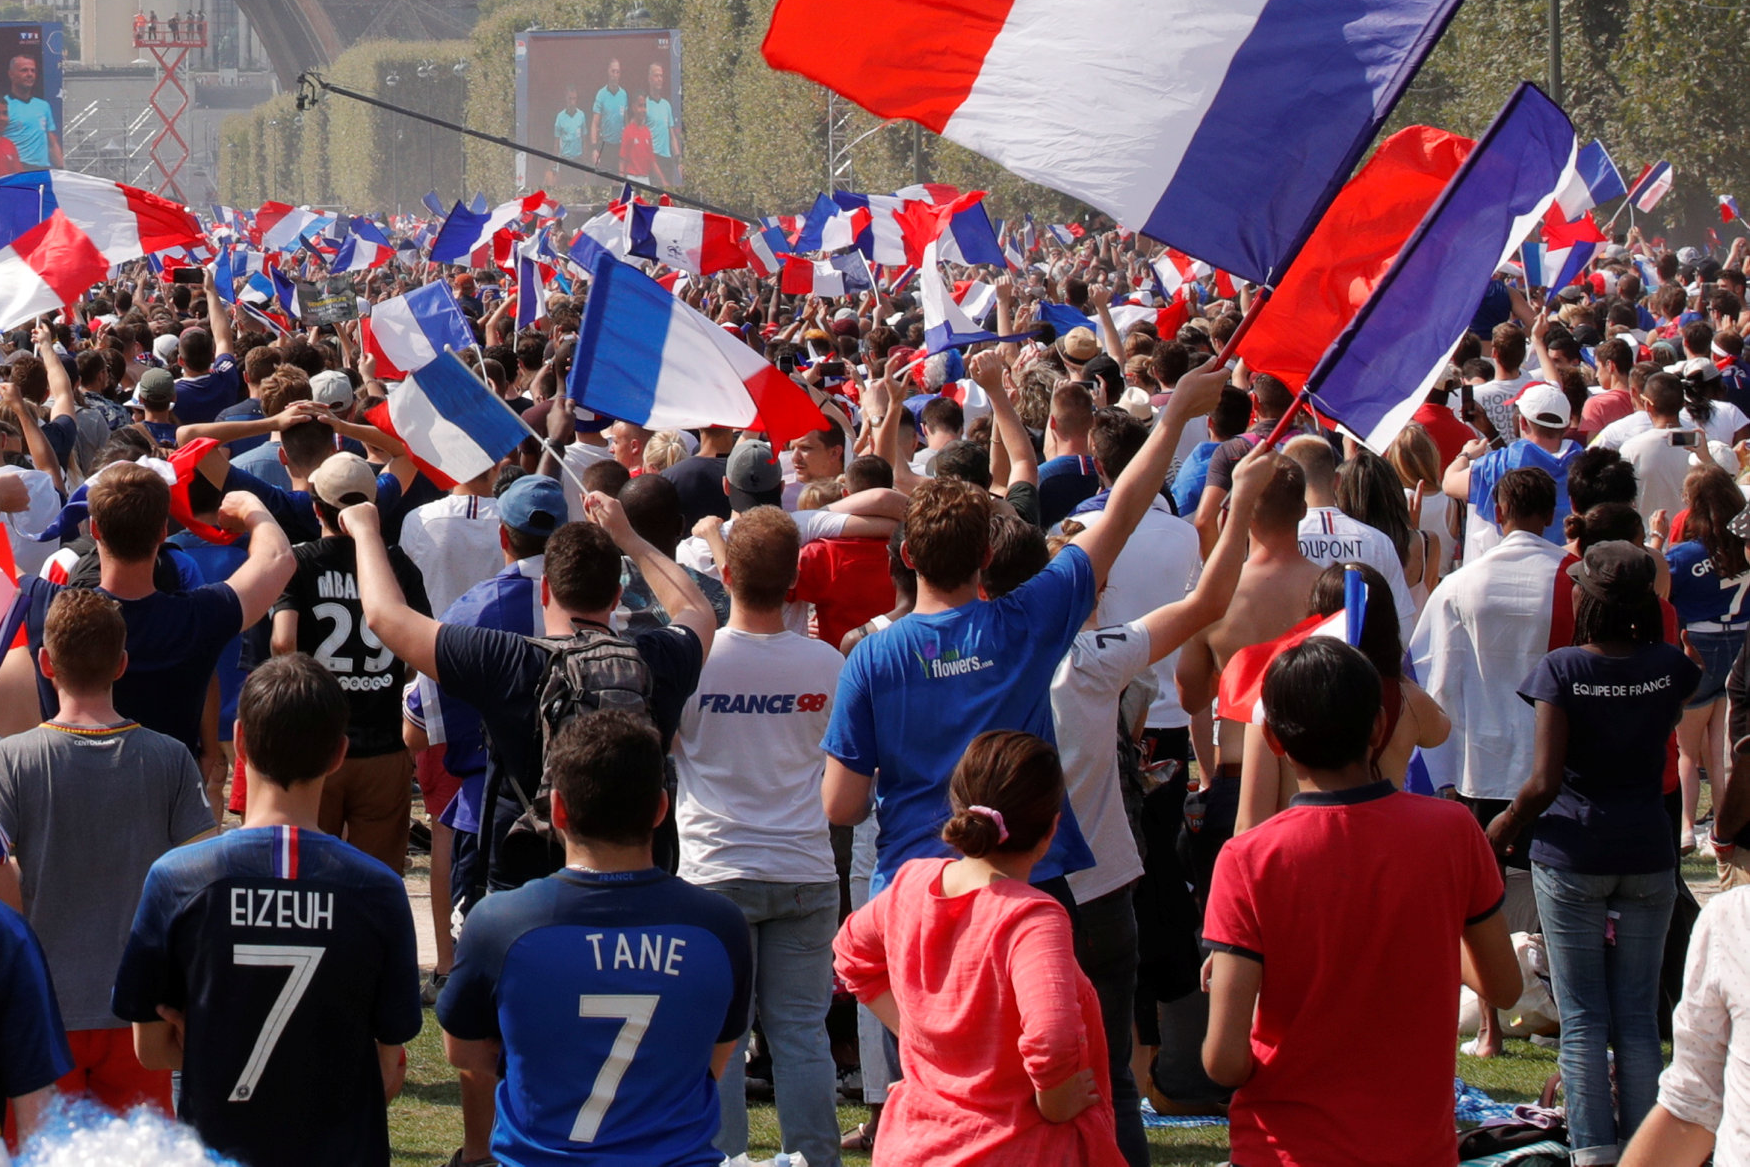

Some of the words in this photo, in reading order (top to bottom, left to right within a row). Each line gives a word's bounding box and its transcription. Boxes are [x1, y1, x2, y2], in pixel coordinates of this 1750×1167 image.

[1297, 540, 1363, 559] DUPONT
[317, 570, 361, 600] MBA
[1572, 682, 1611, 697] ÉQUIPE
[1612, 685, 1627, 697] DE
[1629, 674, 1672, 697] FRANCE
[598, 873, 635, 882] FRANCE
[230, 887, 334, 930] EIZEUH
[585, 932, 687, 976] TANE
[227, 943, 327, 1102] 7
[568, 994, 661, 1143] 7
